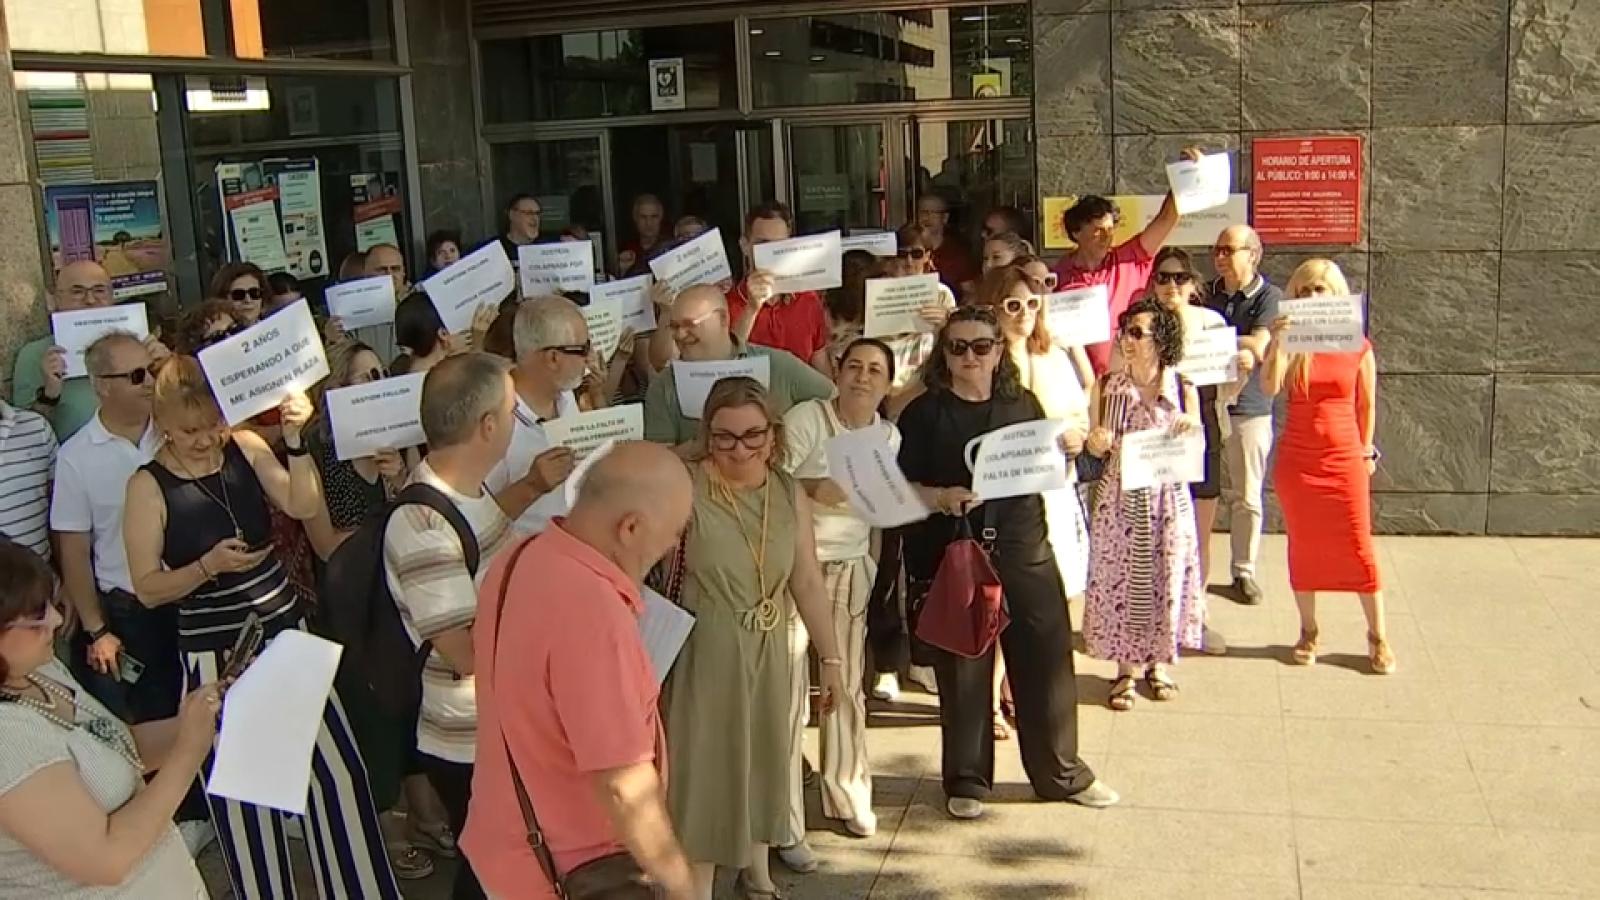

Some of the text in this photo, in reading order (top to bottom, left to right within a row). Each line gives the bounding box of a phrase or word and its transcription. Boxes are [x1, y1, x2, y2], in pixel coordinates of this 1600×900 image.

[1262, 154, 1351, 166] HORARIO DE APERTURA
[1256, 171, 1266, 180] AL
[1267, 168, 1303, 180] PÚBLICO:
[1327, 170, 1348, 180] 14:00
[1287, 334, 1354, 343] ES UN DERECHO
[241, 341, 251, 353] 2
[220, 337, 310, 387] ESPERANDO A QUE
[229, 355, 319, 405] ME ASIGNEN PLAZA
[569, 417, 625, 433] POR LA FALTA DE
[1001, 429, 1036, 440] JUSTICIA
[985, 445, 1052, 463] COLAPSADA POR
[982, 464, 1056, 480] FALTA DE MEDIOS
